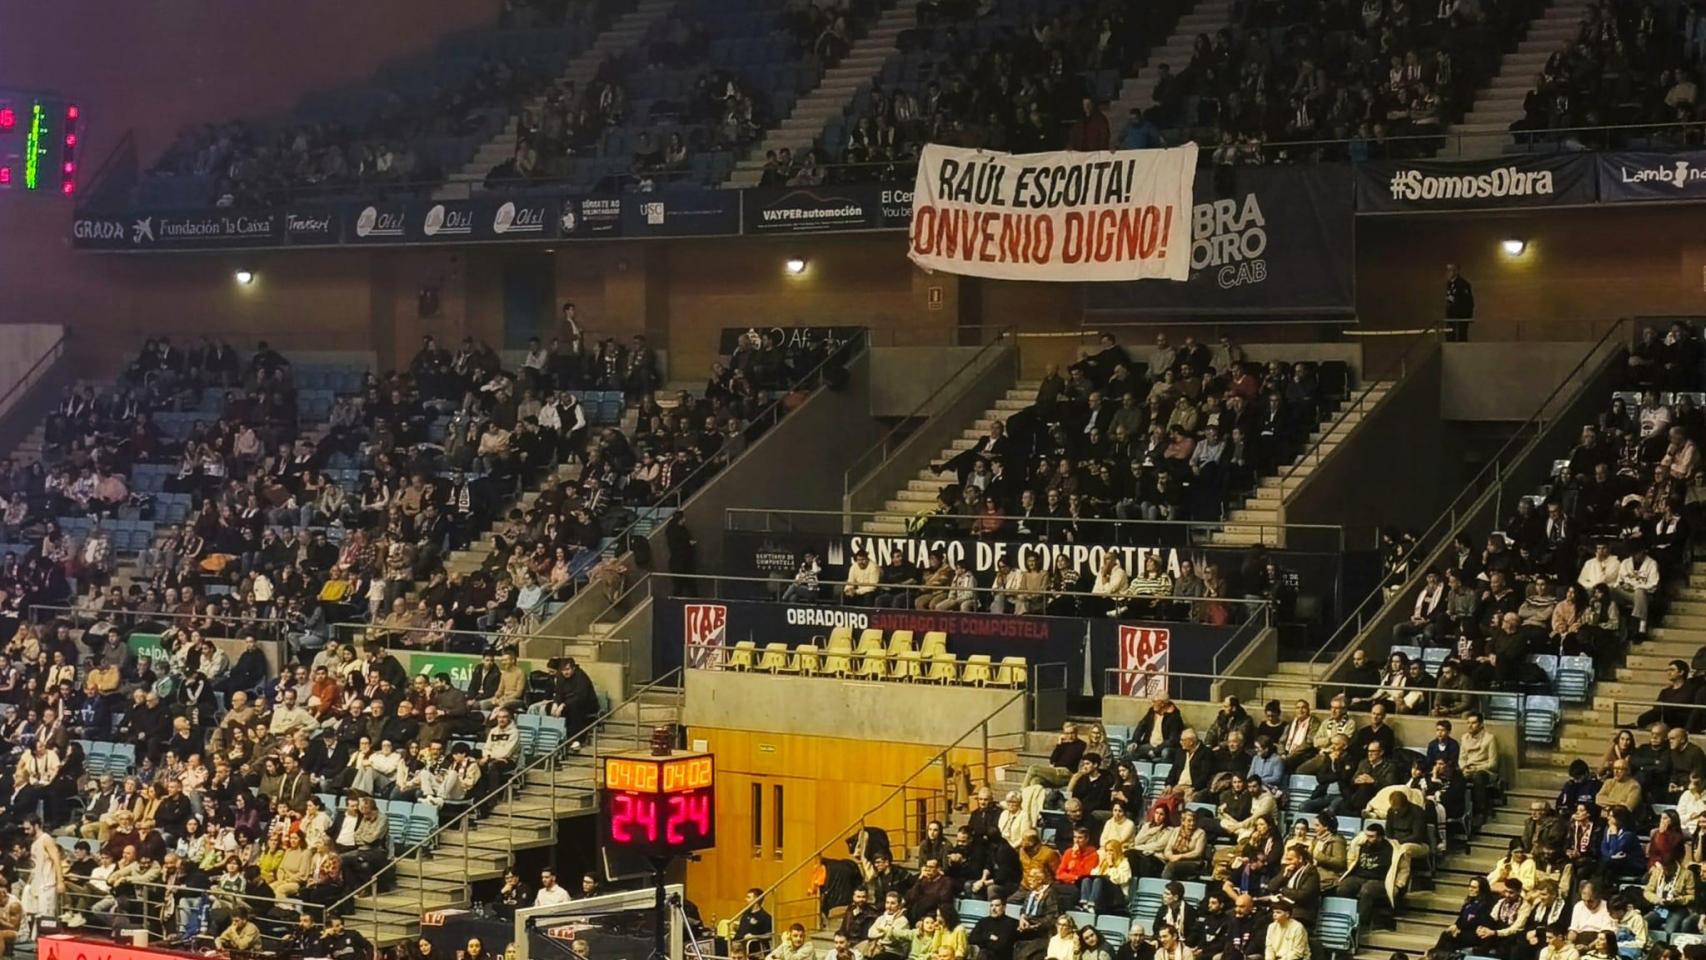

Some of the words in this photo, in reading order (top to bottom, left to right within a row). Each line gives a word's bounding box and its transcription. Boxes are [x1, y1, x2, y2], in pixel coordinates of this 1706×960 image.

[882, 191, 891, 203] El
[939, 157, 1005, 206] RAÚL
[1012, 160, 1136, 208] ESCOITA!
[1390, 167, 1554, 199] #SomosObra
[640, 203, 662, 216] USC
[882, 207, 899, 217] You
[73, 219, 124, 239] GRADA
[160, 218, 220, 235] Fundación
[1062, 205, 1173, 263] DIGNO!
[1218, 259, 1267, 289] CAB
[976, 541, 1007, 572] DE
[1018, 542, 1181, 579] COMPOTEA
[787, 608, 868, 629] OBRADOIRO
[872, 614, 935, 632] SANTIAGO
[940, 617, 956, 633] DE
[960, 618, 1049, 639] COMPOSTELA
[138, 645, 169, 661] SAÍDA
[450, 663, 473, 681] SAÍ
[612, 796, 656, 843] 24
[667, 795, 709, 844] 24
